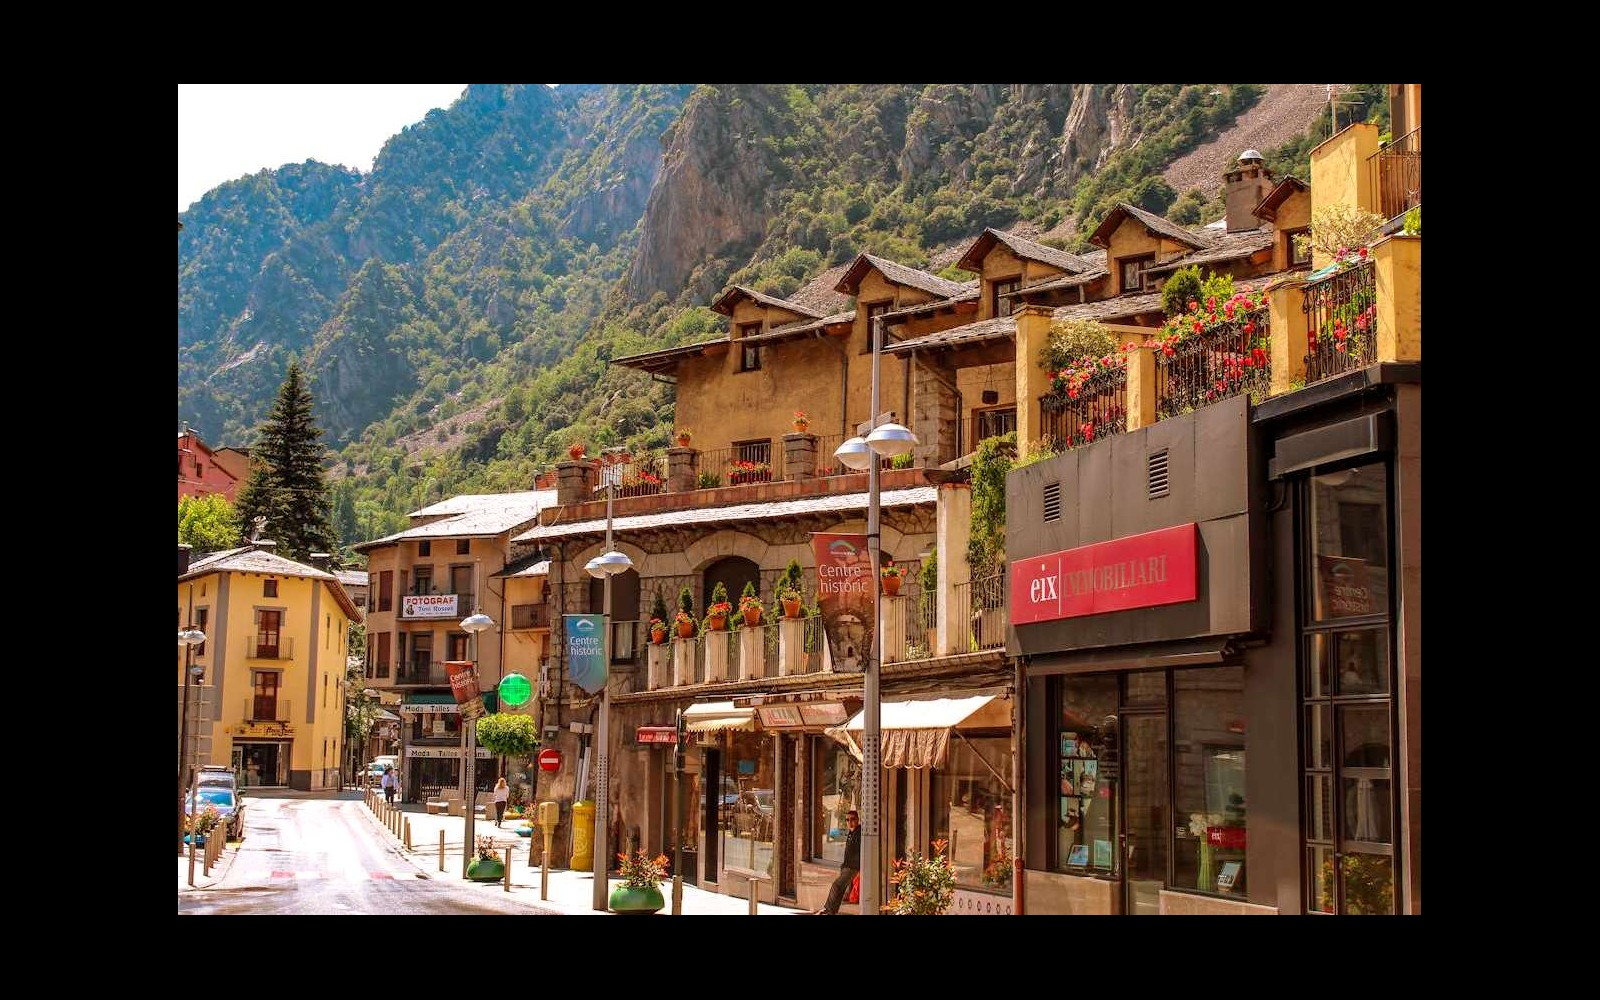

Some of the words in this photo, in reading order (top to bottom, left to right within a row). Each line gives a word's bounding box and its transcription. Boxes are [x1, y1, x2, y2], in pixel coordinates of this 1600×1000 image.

[819, 564, 860, 577] Centre
[1030, 563, 1057, 603] eix
[1063, 555, 1166, 597] IMMOBILIARI
[406, 596, 454, 605] FOTOGRAF
[570, 637, 599, 645] Centre
